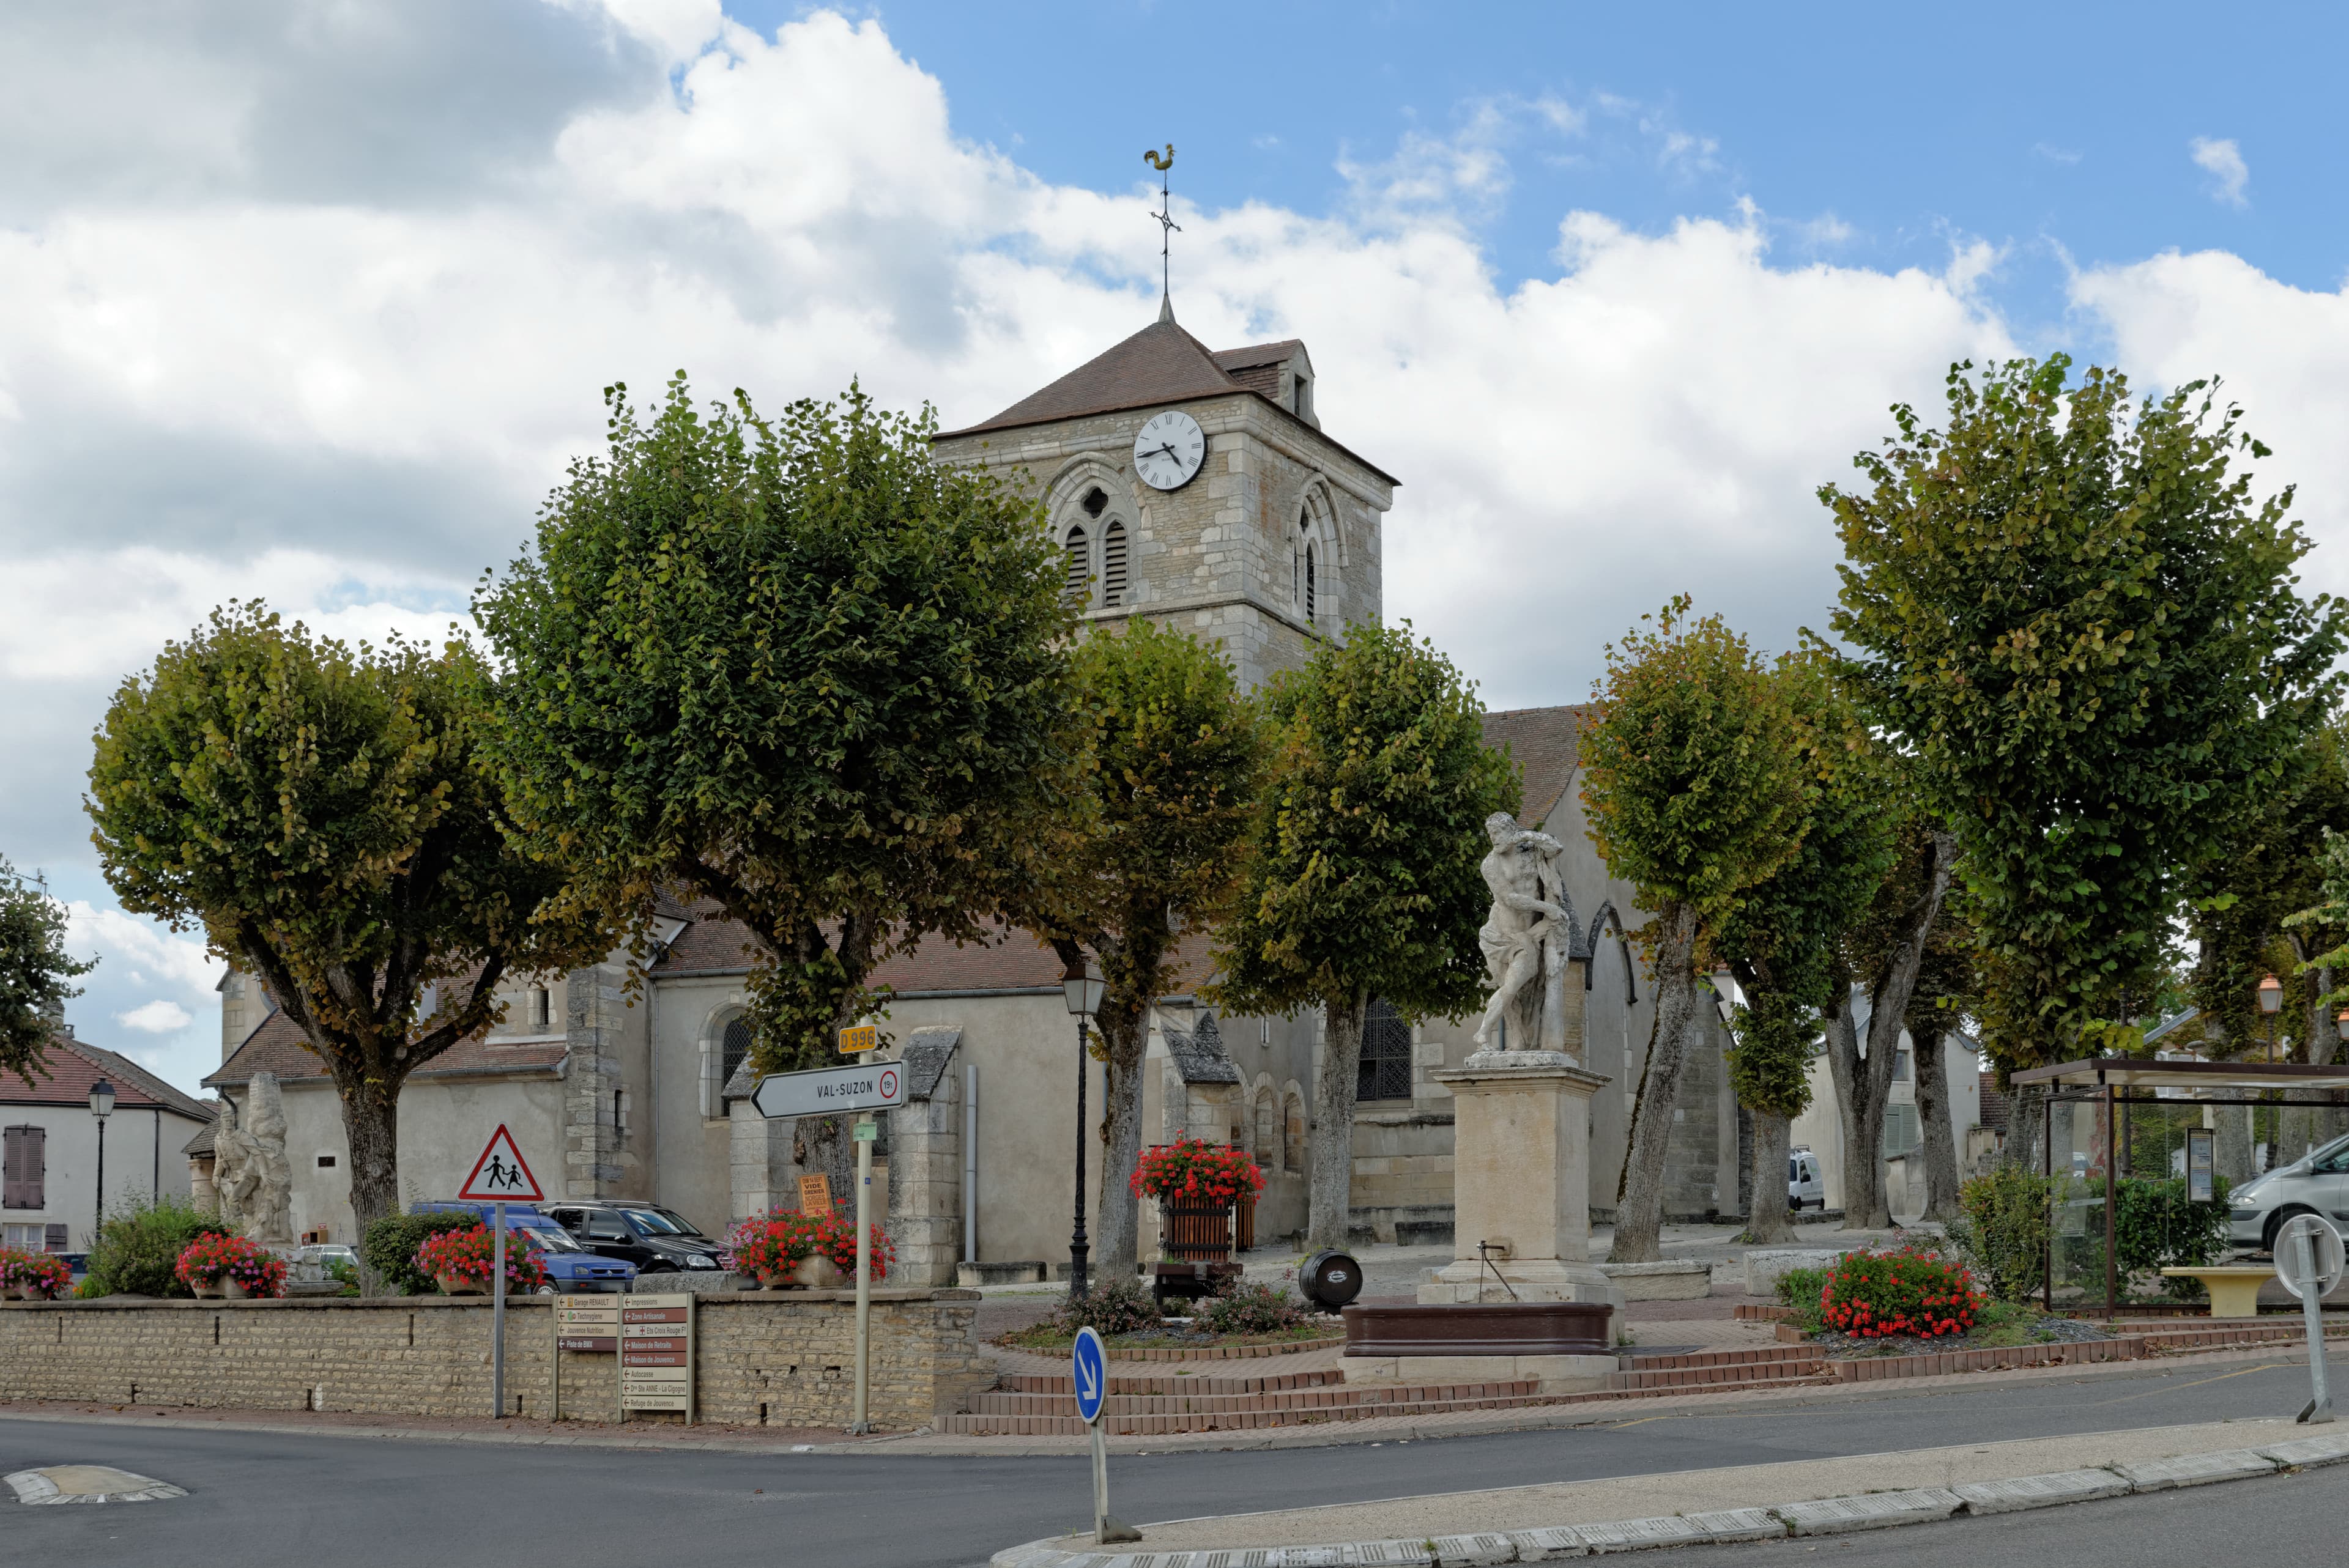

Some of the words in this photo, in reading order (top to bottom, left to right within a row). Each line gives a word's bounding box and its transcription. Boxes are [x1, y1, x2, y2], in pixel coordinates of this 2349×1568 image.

[841, 1034, 848, 1048] D
[851, 1030, 874, 1047] 996
[817, 1081, 873, 1098] VAL-SUZON
[667, 1326, 680, 1335] Rouge
[667, 1385, 685, 1394] Cigogne
[631, 1399, 646, 1408] Refuge
